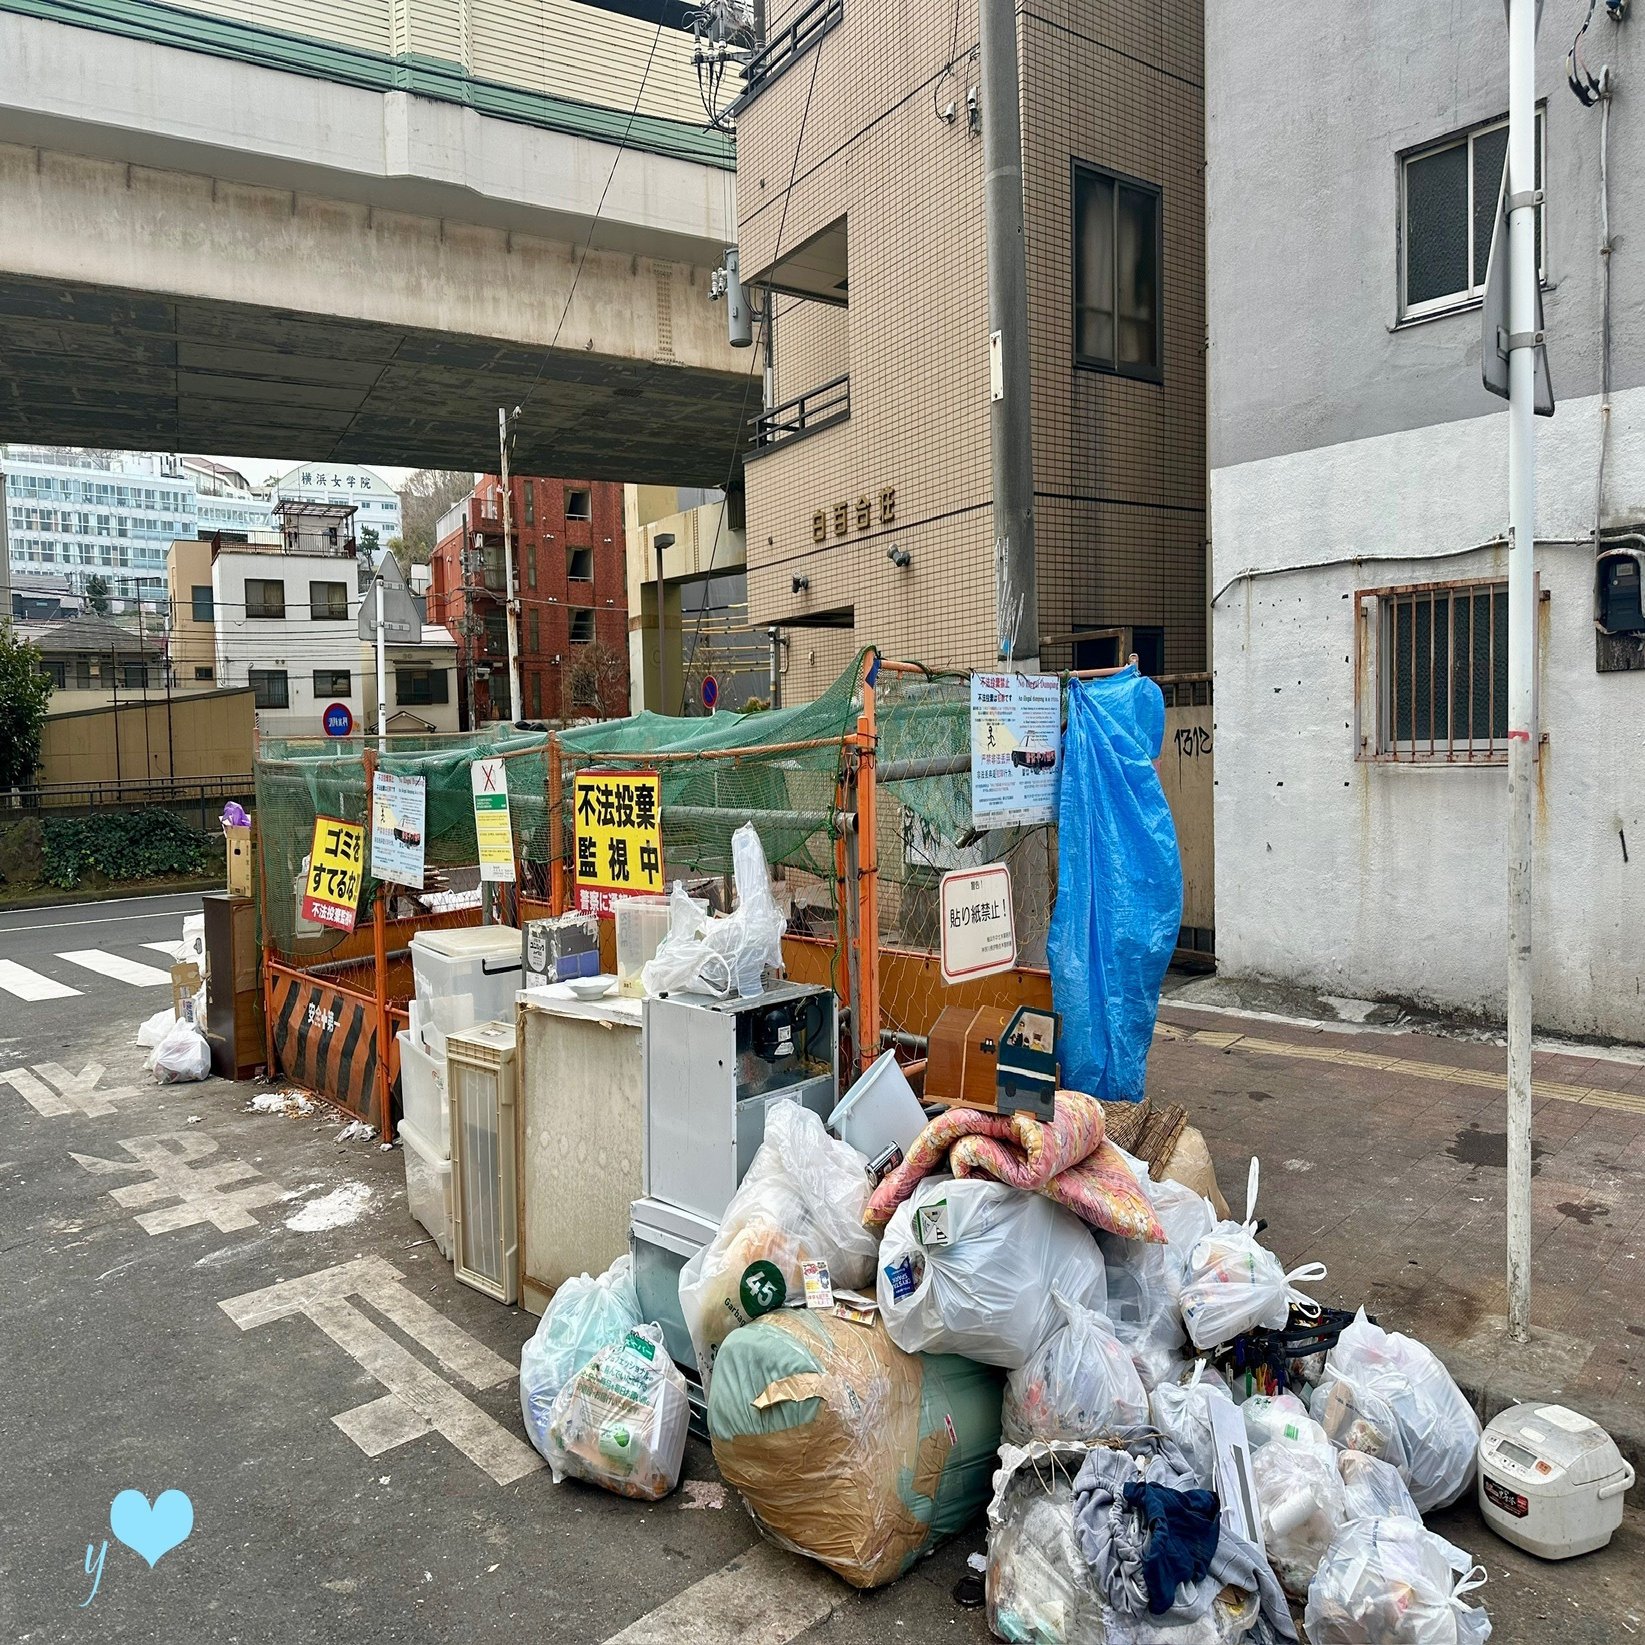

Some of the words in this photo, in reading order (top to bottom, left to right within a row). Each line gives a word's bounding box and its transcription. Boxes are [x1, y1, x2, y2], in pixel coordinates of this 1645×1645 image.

[301, 471, 371, 490] 横浜女学院
[812, 485, 896, 543] 白百合荘
[577, 783, 656, 830] 不法投棄
[324, 828, 361, 862] ゴミを
[578, 836, 660, 885] 監視中
[724, 1297, 746, 1327] Garbag
